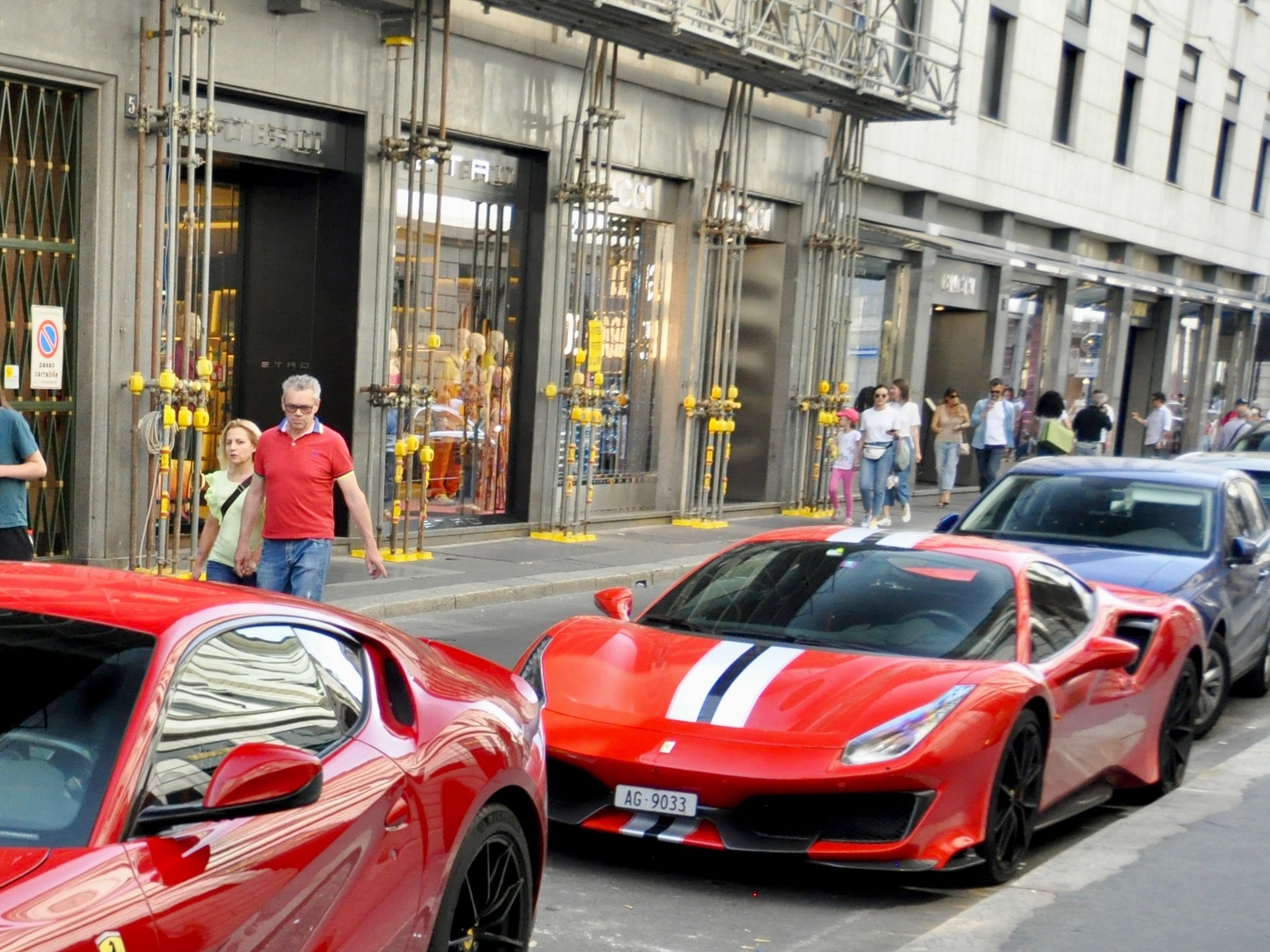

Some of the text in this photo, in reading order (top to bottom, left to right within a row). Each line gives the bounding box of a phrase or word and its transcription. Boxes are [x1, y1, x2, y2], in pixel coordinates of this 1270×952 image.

[128, 96, 136, 114] 5
[624, 789, 686, 812] AG 9033
